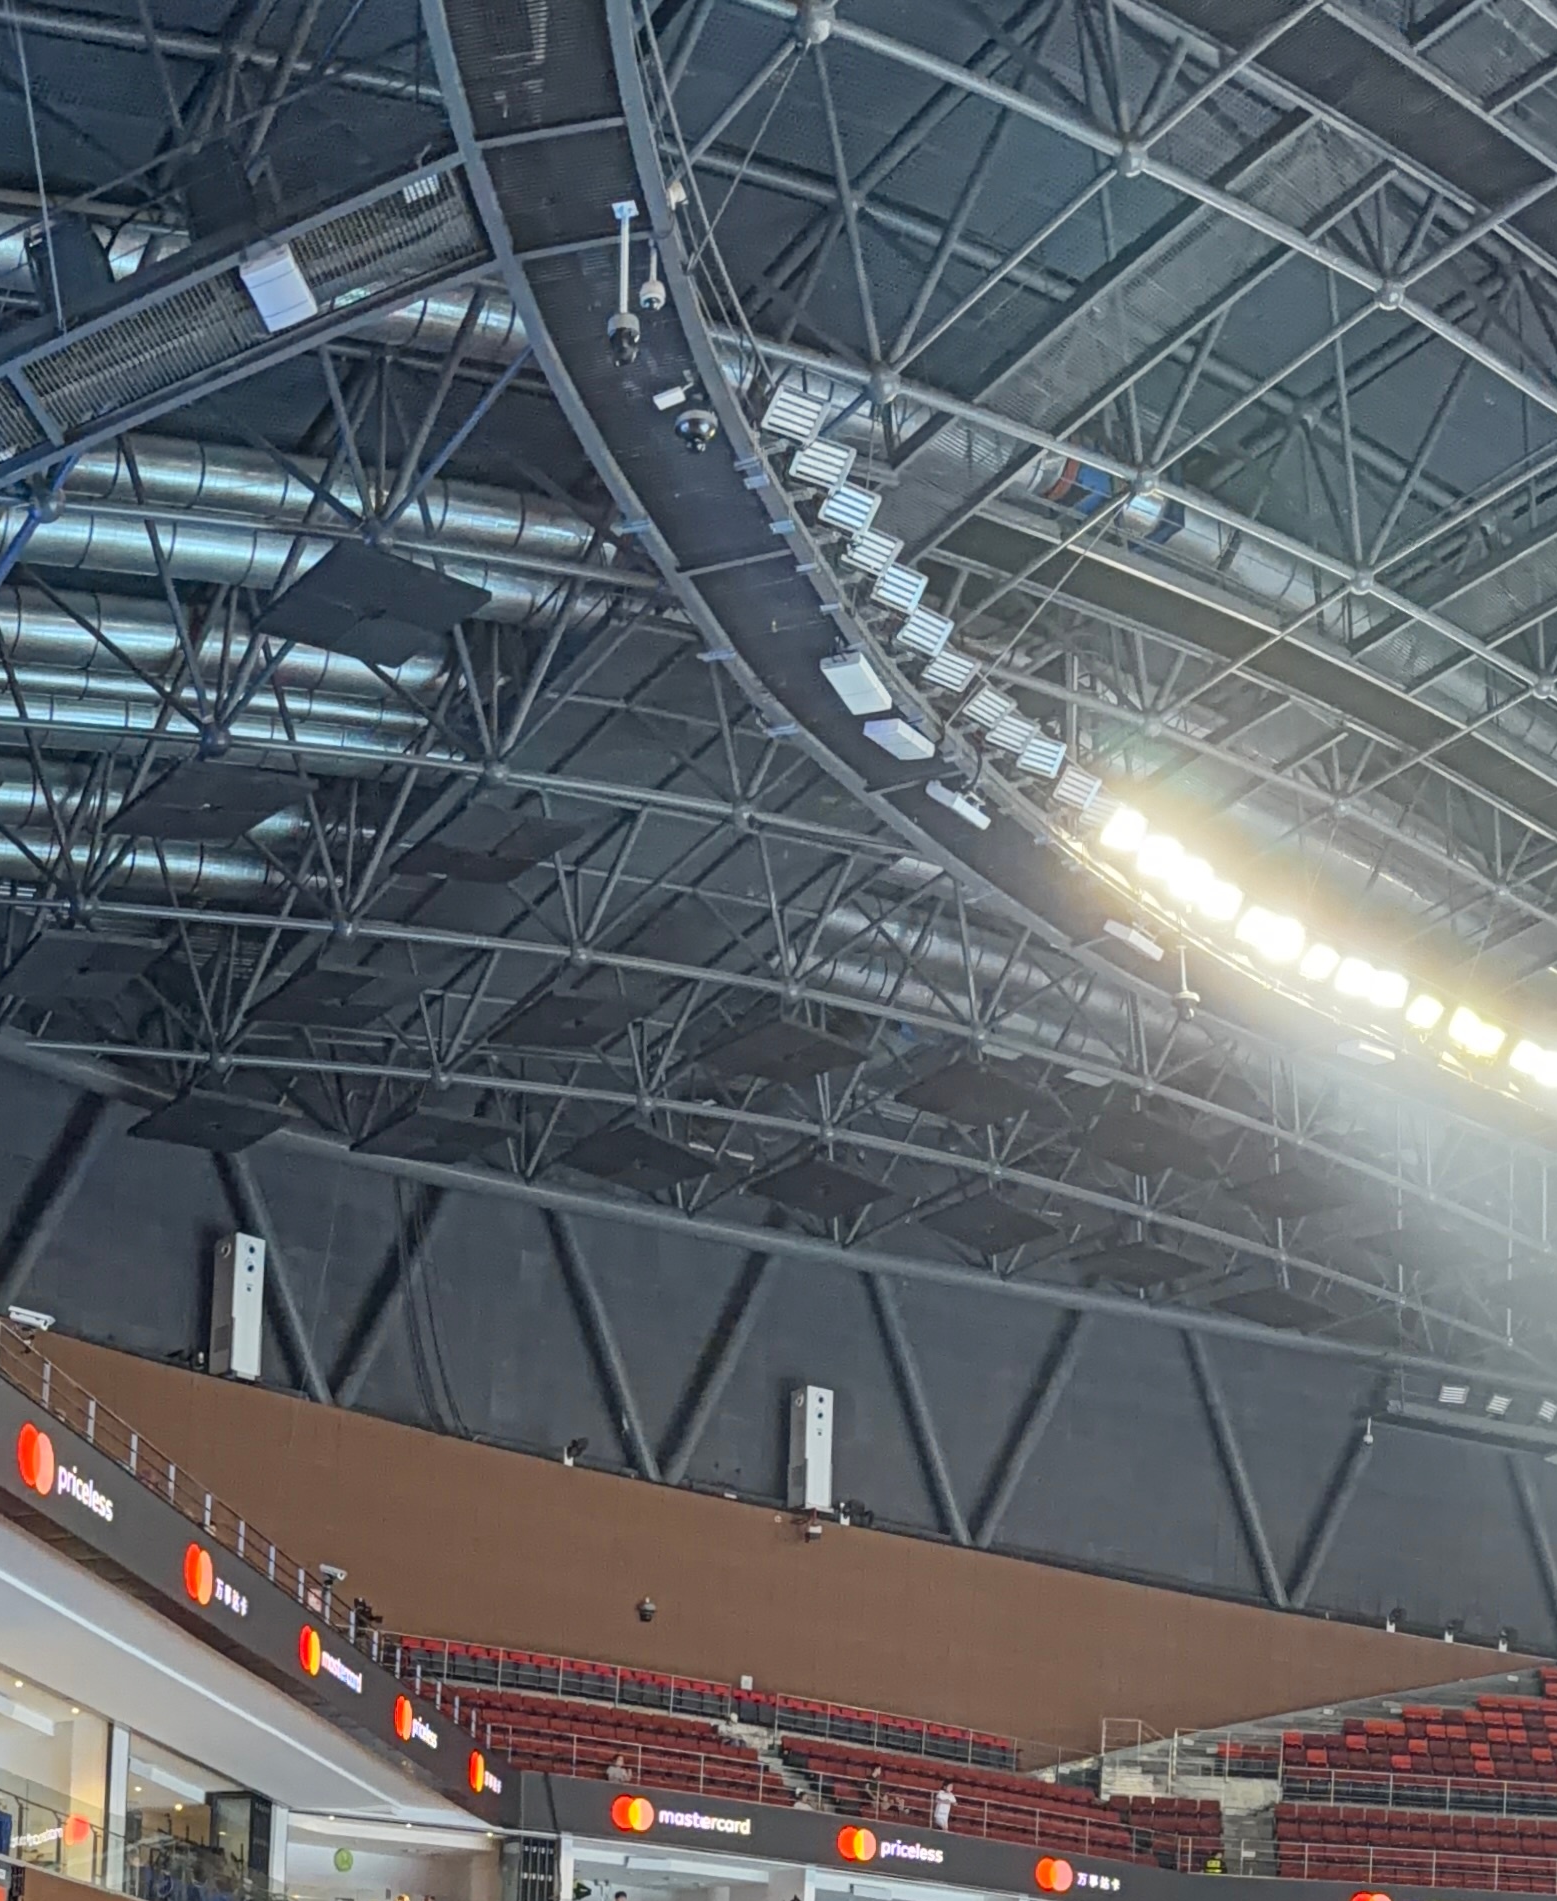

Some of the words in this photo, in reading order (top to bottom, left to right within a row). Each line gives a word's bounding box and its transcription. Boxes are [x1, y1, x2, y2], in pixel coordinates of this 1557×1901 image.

[57, 1465, 114, 1522] priceless
[658, 1809, 751, 1835] mastercard
[880, 1839, 944, 1864] priceless
